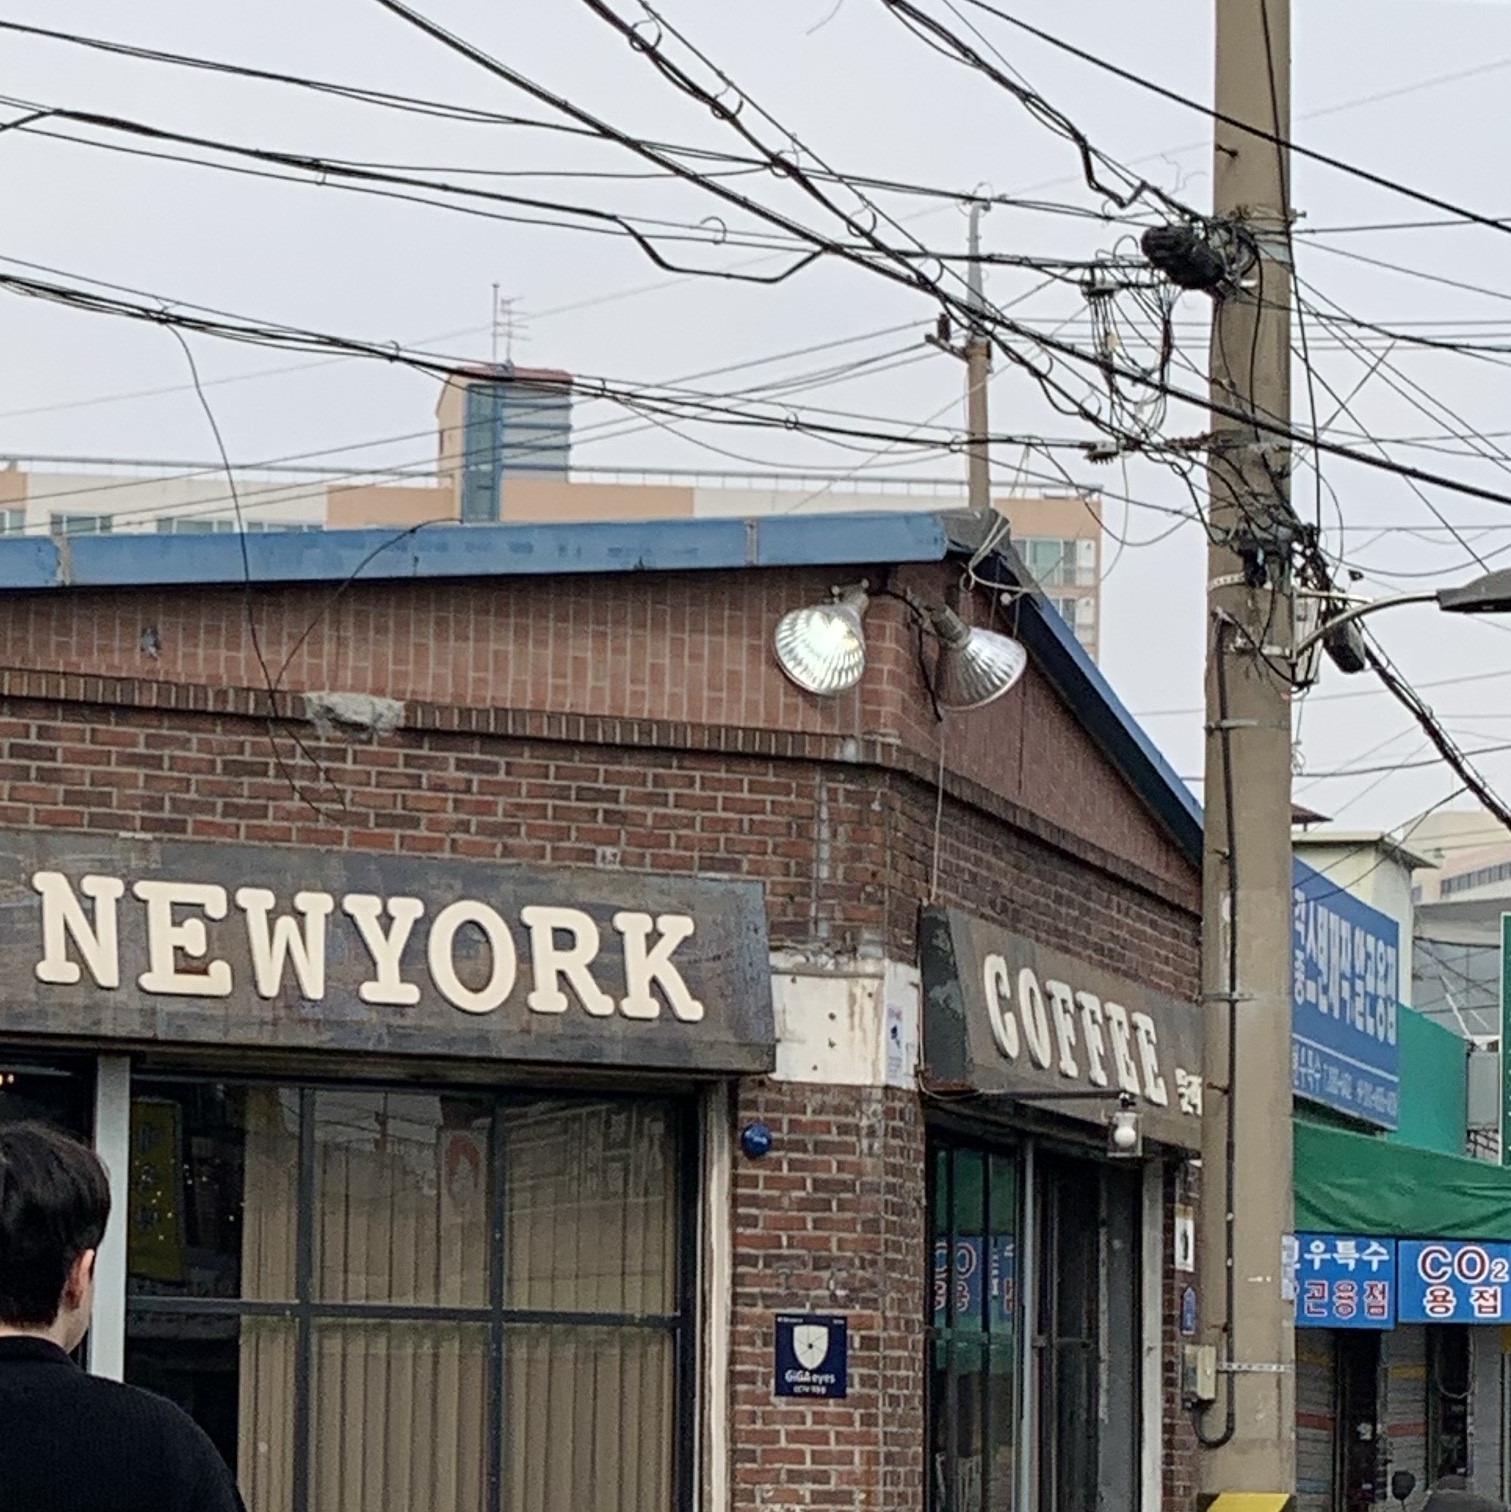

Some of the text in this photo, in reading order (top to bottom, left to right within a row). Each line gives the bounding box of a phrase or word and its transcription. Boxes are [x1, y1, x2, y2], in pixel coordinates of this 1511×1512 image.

[31, 869, 705, 1024] NEWYORK
[984, 953, 1169, 1108] COFFEE
[1294, 1239, 1389, 1273] 우특수
[1294, 1279, 1389, 1320] 곤용접
